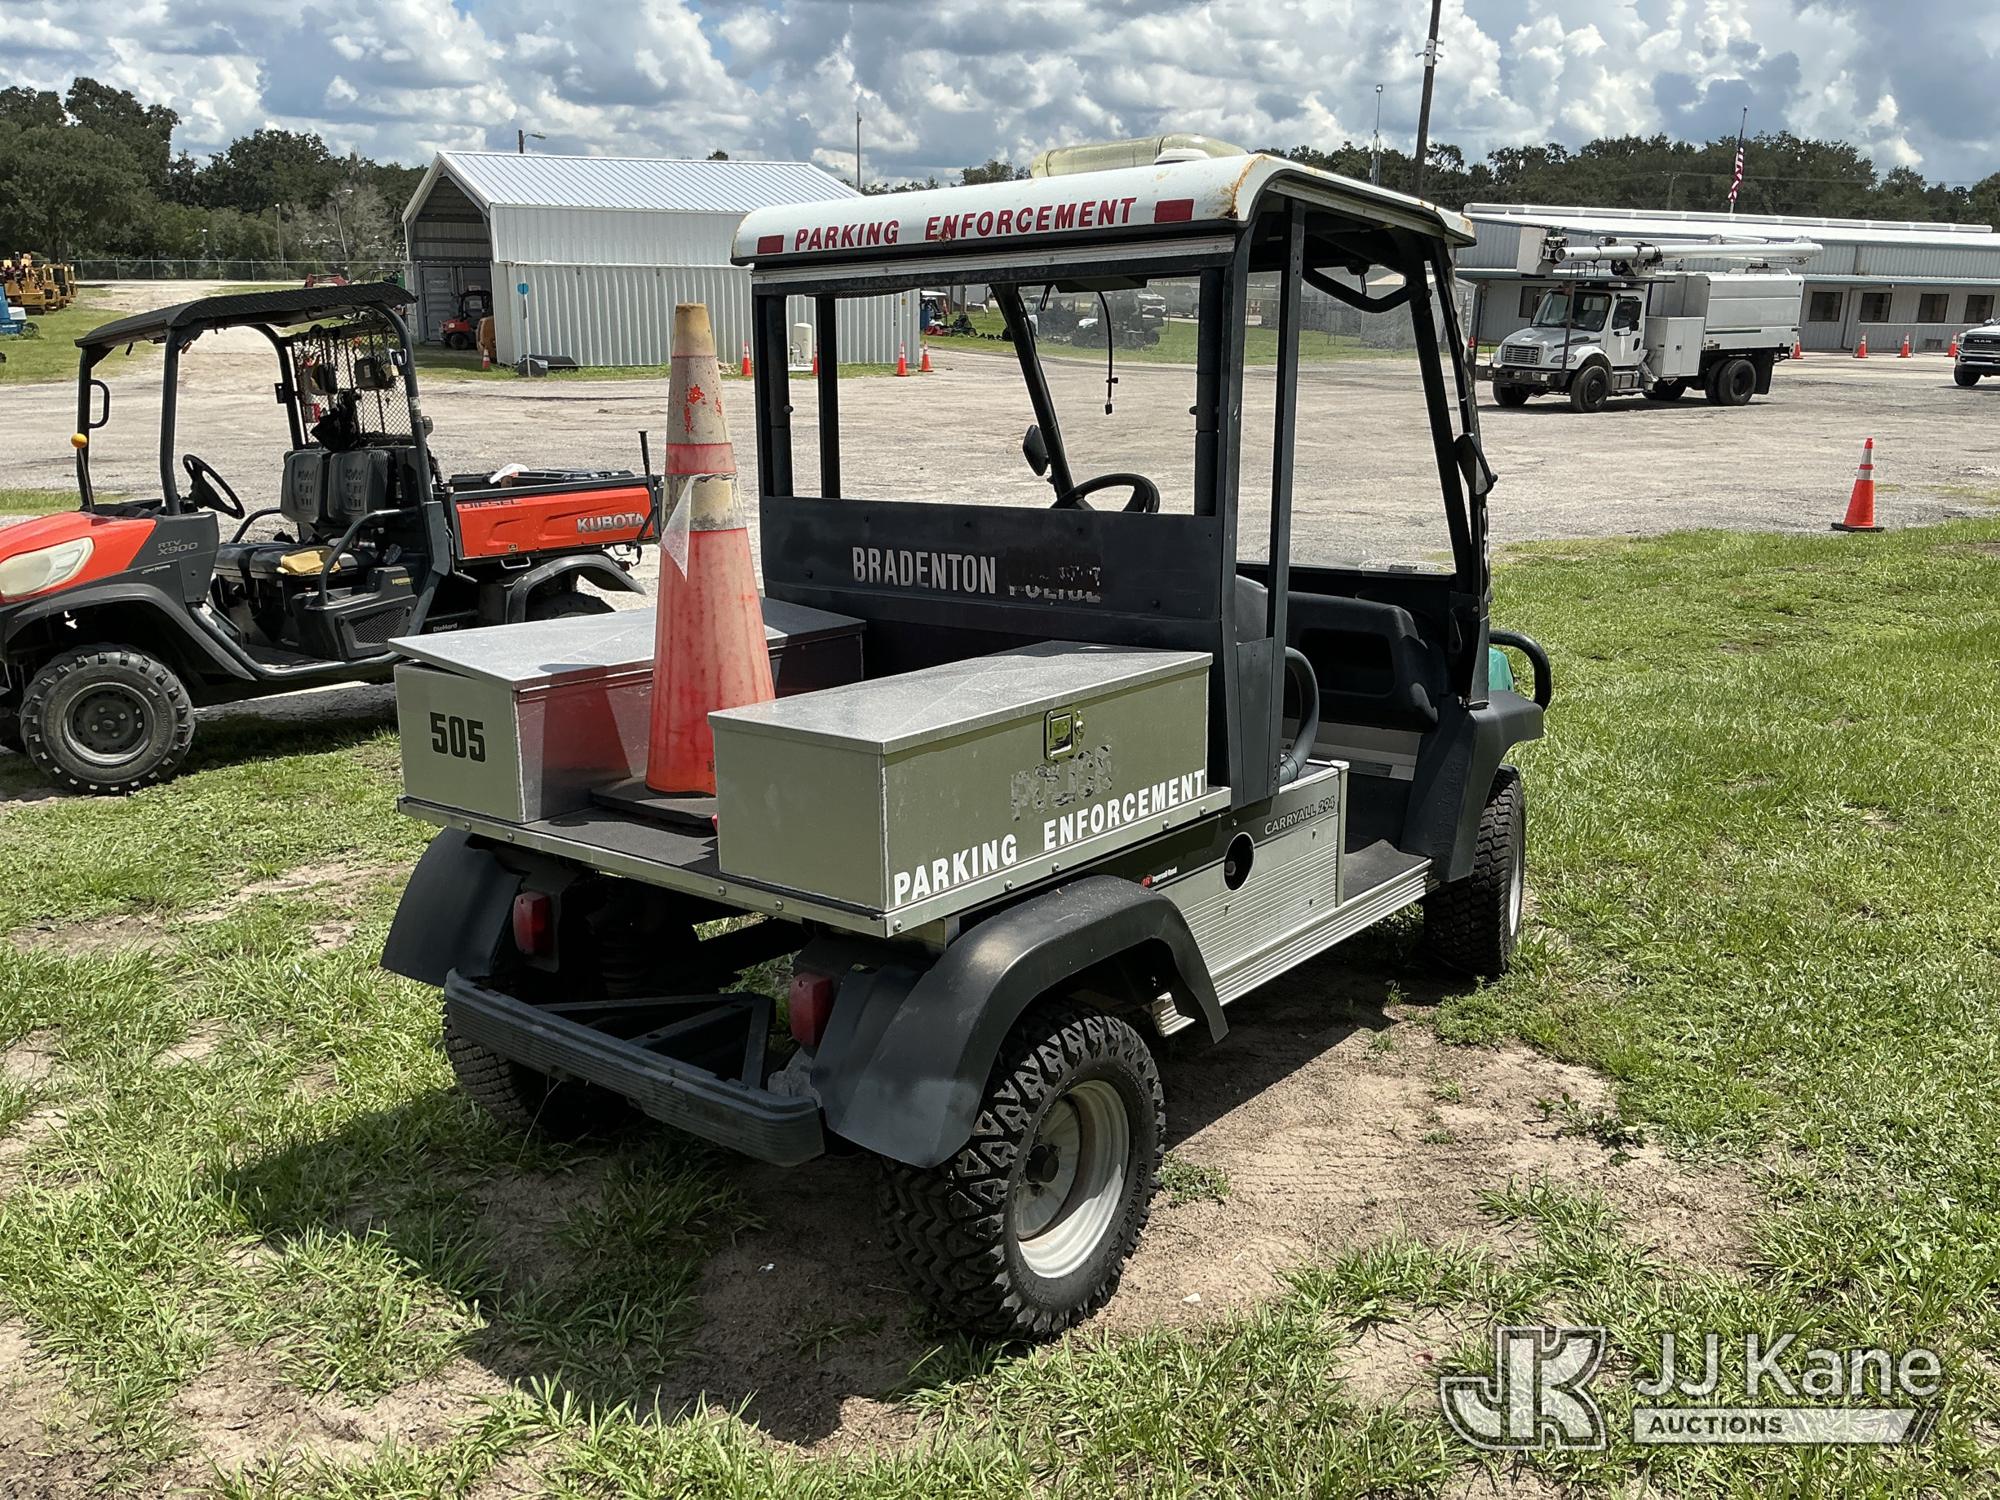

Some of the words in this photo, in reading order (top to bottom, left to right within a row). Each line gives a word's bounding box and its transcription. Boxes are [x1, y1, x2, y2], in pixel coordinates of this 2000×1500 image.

[795, 220, 899, 252] PARKING
[925, 197, 1137, 241] ENFORCEMENT
[158, 540, 181, 549] RTV
[577, 512, 646, 533] KUBOTA
[157, 542, 198, 556] X900
[852, 546, 996, 595] BRADENTON
[429, 711, 486, 763] 505
[1264, 804, 1317, 835] CARRYALL
[1317, 796, 1336, 814] 294
[893, 834, 1017, 907] PARKING
[1043, 769, 1205, 852] ENFORCEMENT
